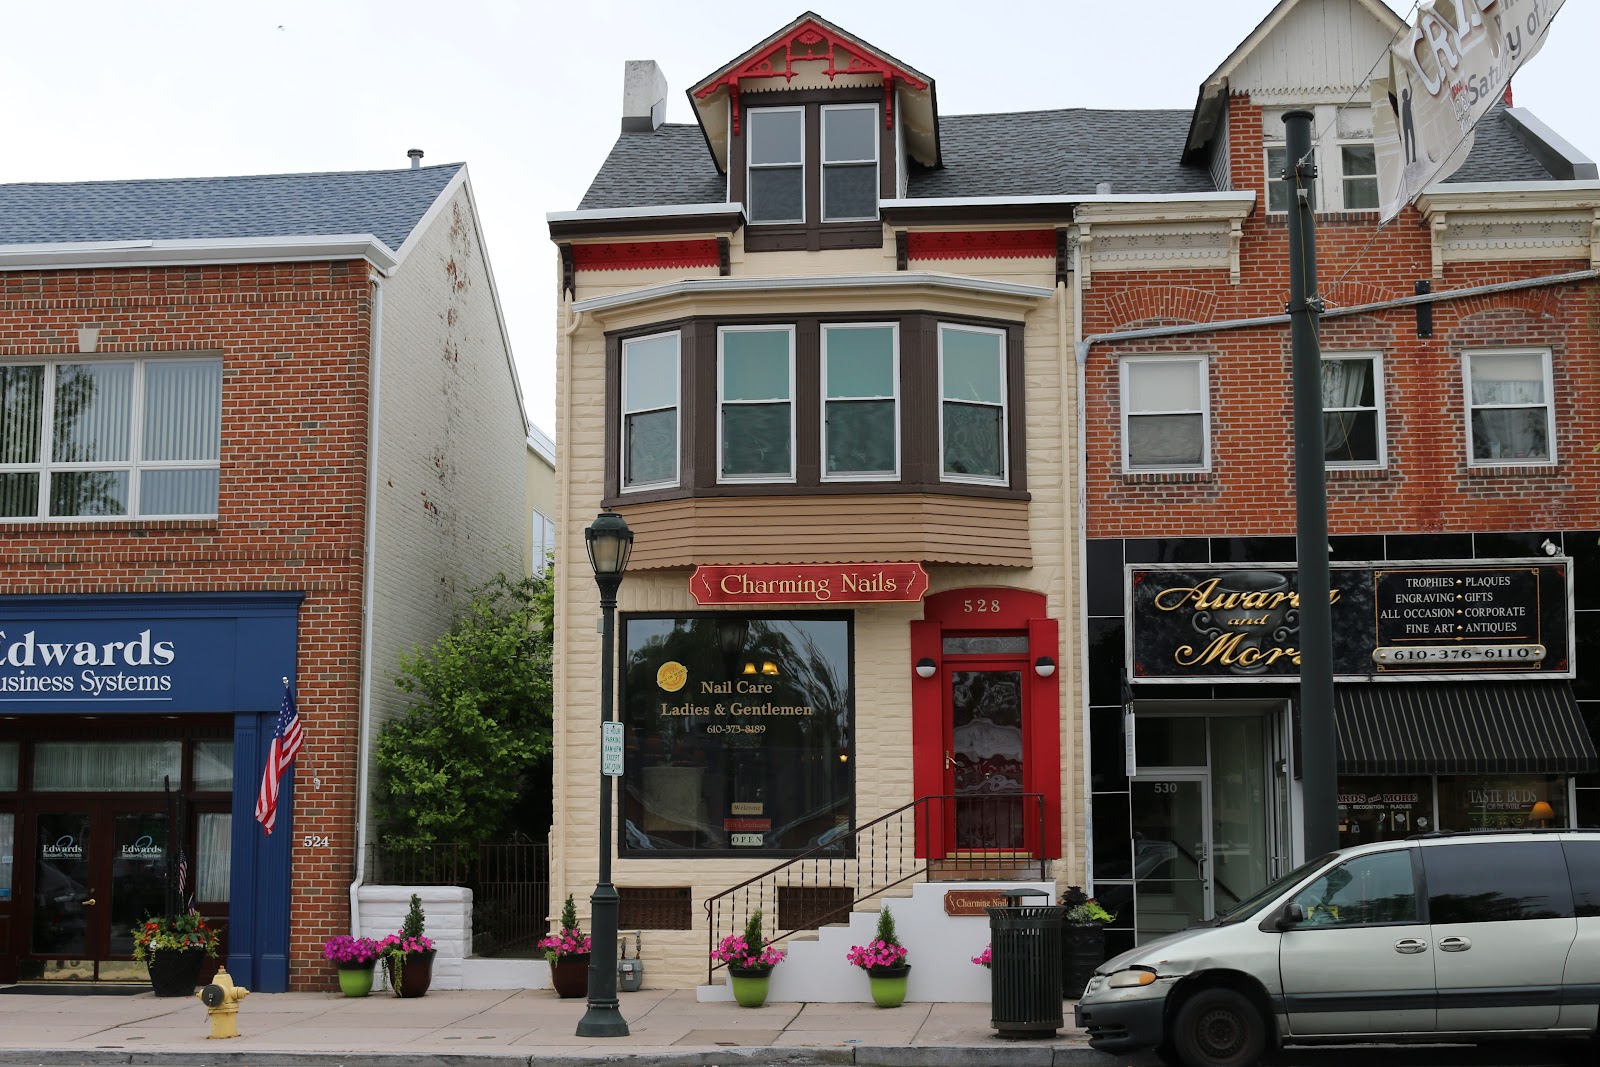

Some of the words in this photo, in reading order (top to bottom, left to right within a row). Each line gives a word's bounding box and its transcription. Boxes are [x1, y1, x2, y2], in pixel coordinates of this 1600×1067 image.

[720, 573, 831, 600] Charming
[840, 571, 897, 593] Nails
[1406, 577, 1454, 588] TROPHIES
[1465, 576, 1511, 587] PLAQUES
[1395, 593, 1455, 604] ENGRAVING
[1464, 592, 1493, 602] GIFTS
[963, 598, 1001, 613] 528
[1227, 613, 1269, 625] and
[1380, 609, 1400, 619] ALL
[1404, 608, 1455, 618] OCCASION
[1464, 607, 1526, 618] CORPORATE
[1405, 624, 1429, 634] FINE
[1433, 623, 1455, 634] ART
[1465, 622, 1517, 634] ANTIQUES
[1394, 648, 1530, 661] 610-376-6110
[80, 669, 172, 696] Systems
[700, 681, 732, 694] Nail
[736, 680, 773, 694] Care
[661, 703, 710, 716] Ladies
[714, 703, 726, 716] &
[730, 702, 813, 716] Gentlemen
[706, 724, 766, 734] 610-373-8189
[605, 736, 621, 744] PARKING
[1154, 783, 1178, 794] 530
[1383, 794, 1418, 802] MORE
[1469, 789, 1503, 803] TASTE
[1507, 789, 1537, 802] BUDS
[304, 836, 330, 847] 524
[43, 845, 82, 853] Edwards
[122, 845, 162, 853] Edwards
